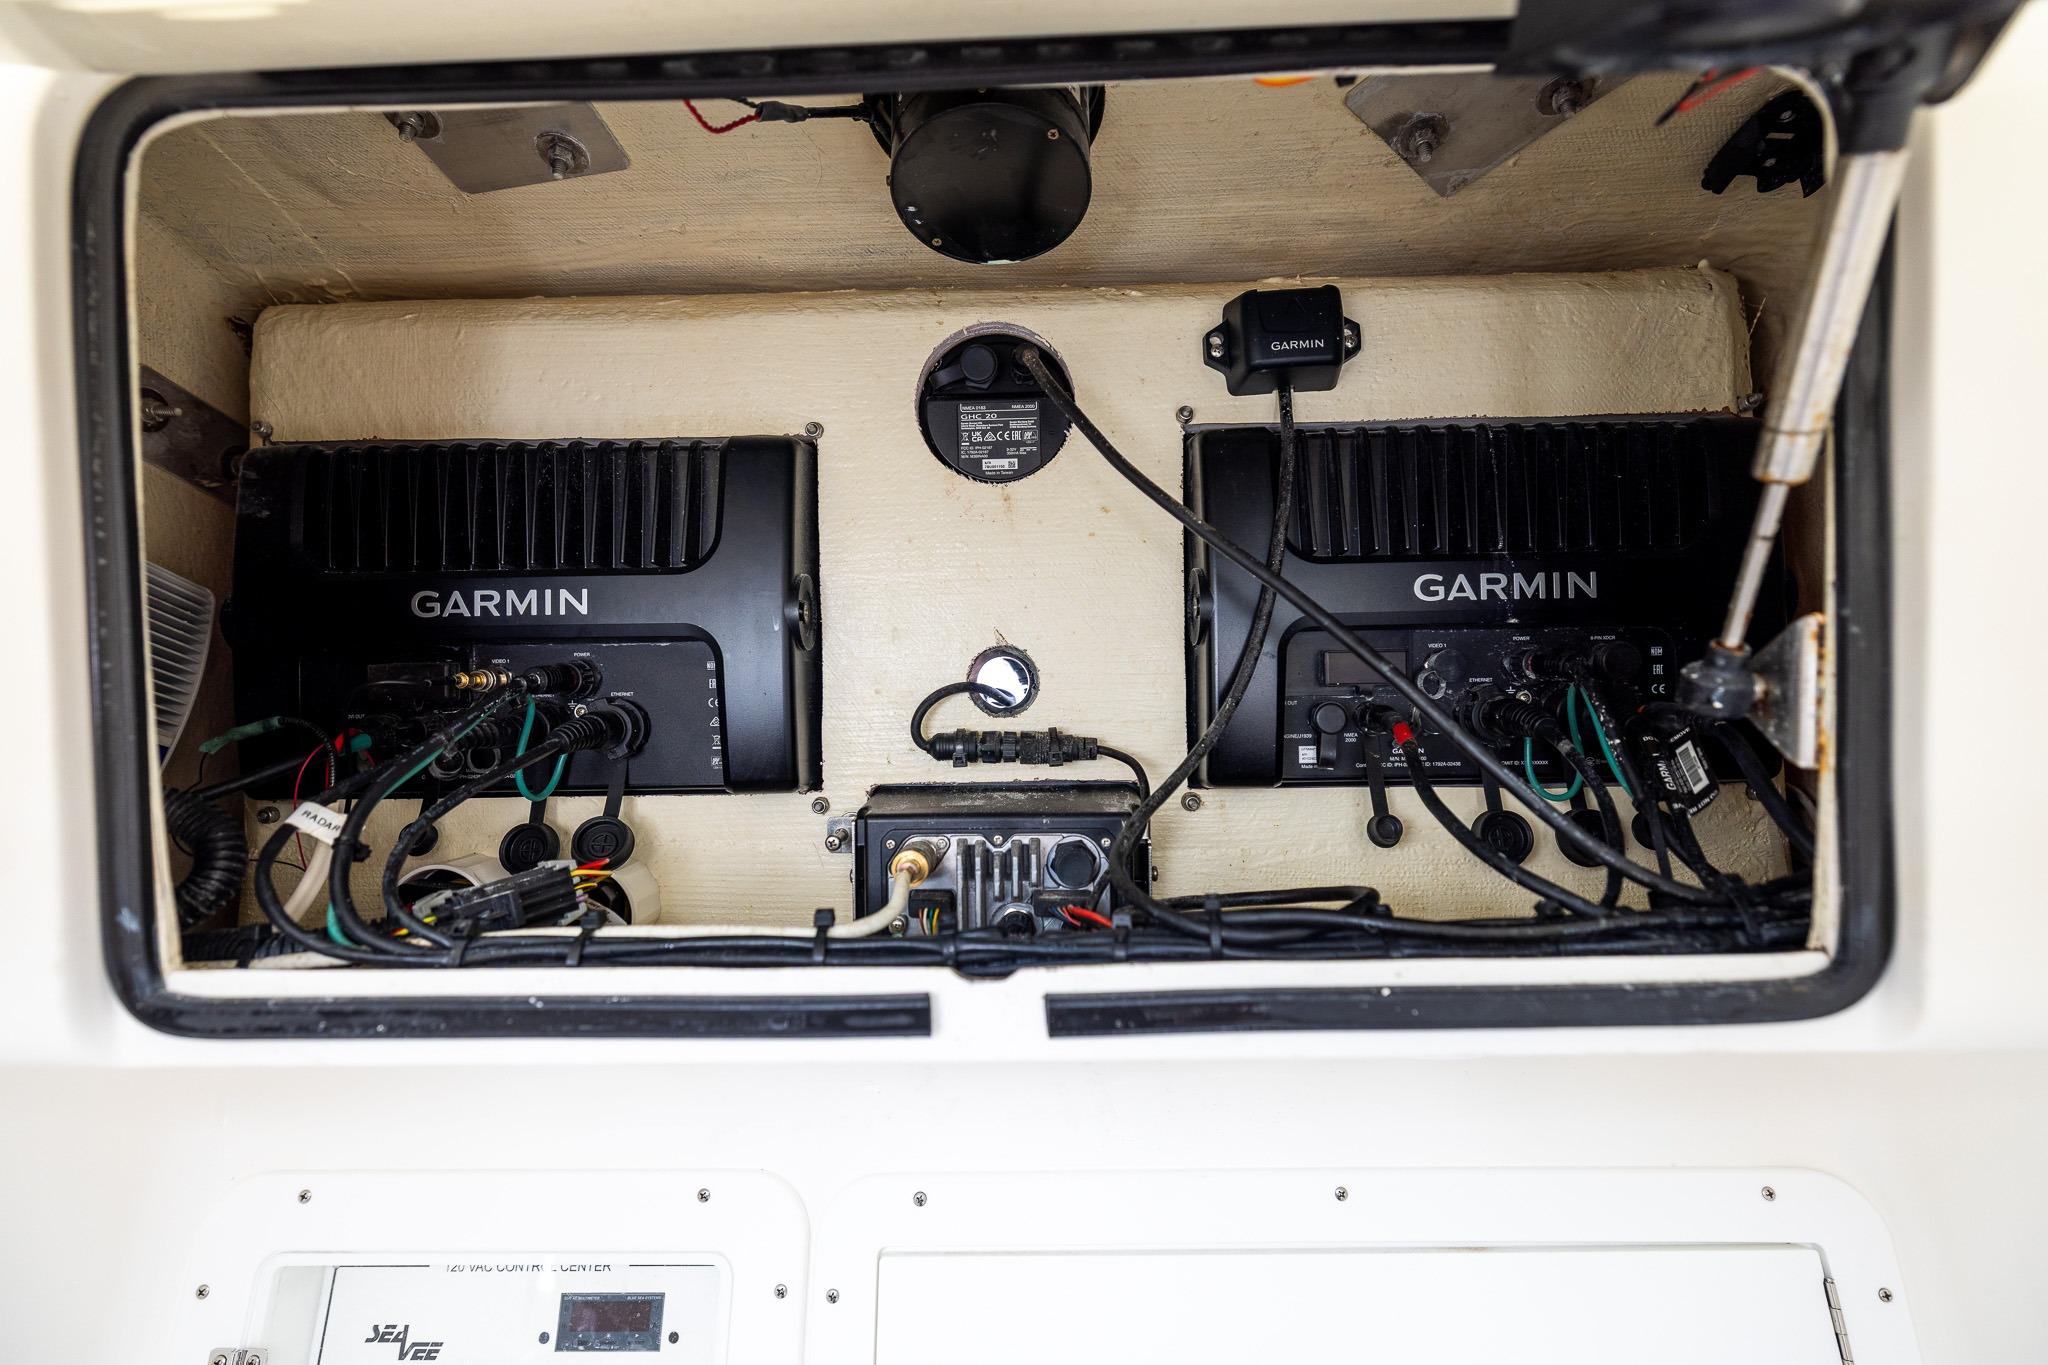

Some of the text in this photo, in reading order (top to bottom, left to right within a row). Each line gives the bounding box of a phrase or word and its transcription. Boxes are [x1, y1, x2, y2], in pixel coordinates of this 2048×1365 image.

[1270, 339, 1325, 351] GARMIN
[1413, 571, 1598, 602] GARMIN
[411, 588, 588, 618] GARMIN
[301, 809, 342, 832] RADAR
[560, 1264, 612, 1272] CENTER
[365, 1325, 409, 1343] SEA
[398, 1337, 444, 1360] VEE
